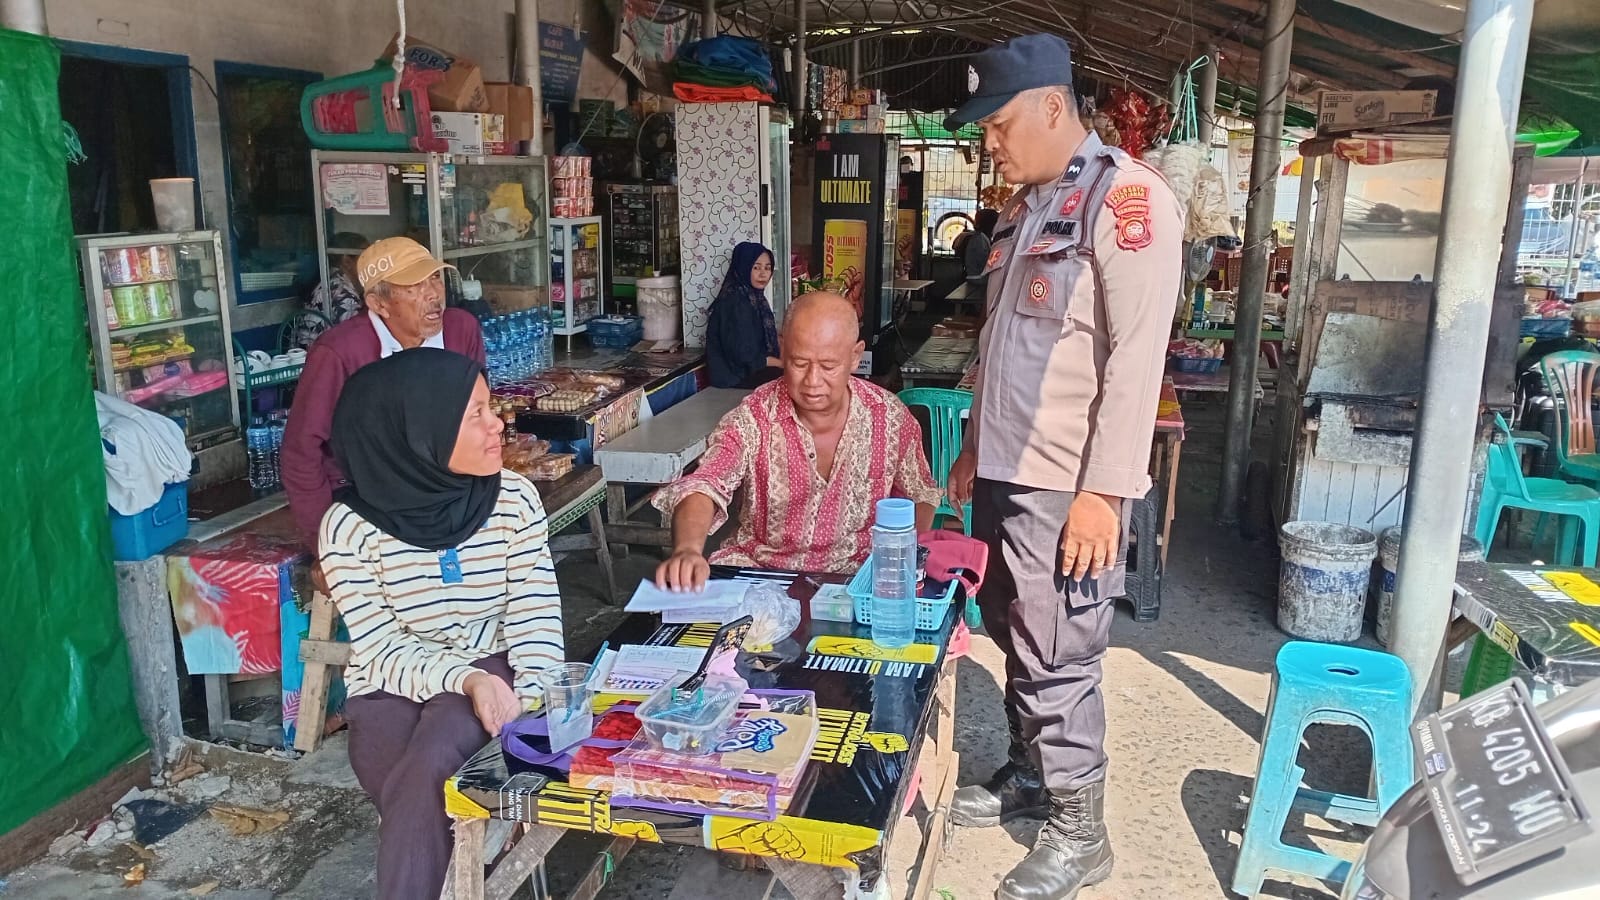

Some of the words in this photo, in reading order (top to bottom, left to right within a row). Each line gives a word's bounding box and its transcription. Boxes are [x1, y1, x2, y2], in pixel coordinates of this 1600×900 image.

[833, 154, 838, 178] I
[840, 154, 860, 178] AM
[820, 180, 872, 204] ULTIMATE
[802, 654, 883, 676] ULTIMATE
[884, 661, 915, 678] AM
[916, 663, 926, 679] I
[1469, 692, 1513, 727] KB
[714, 717, 783, 752] Polly
[836, 711, 871, 769] EXTRAJOSS
[1419, 726, 1435, 754] YAMAHA
[1482, 727, 1541, 786] 4205
[1509, 790, 1565, 835] MU
